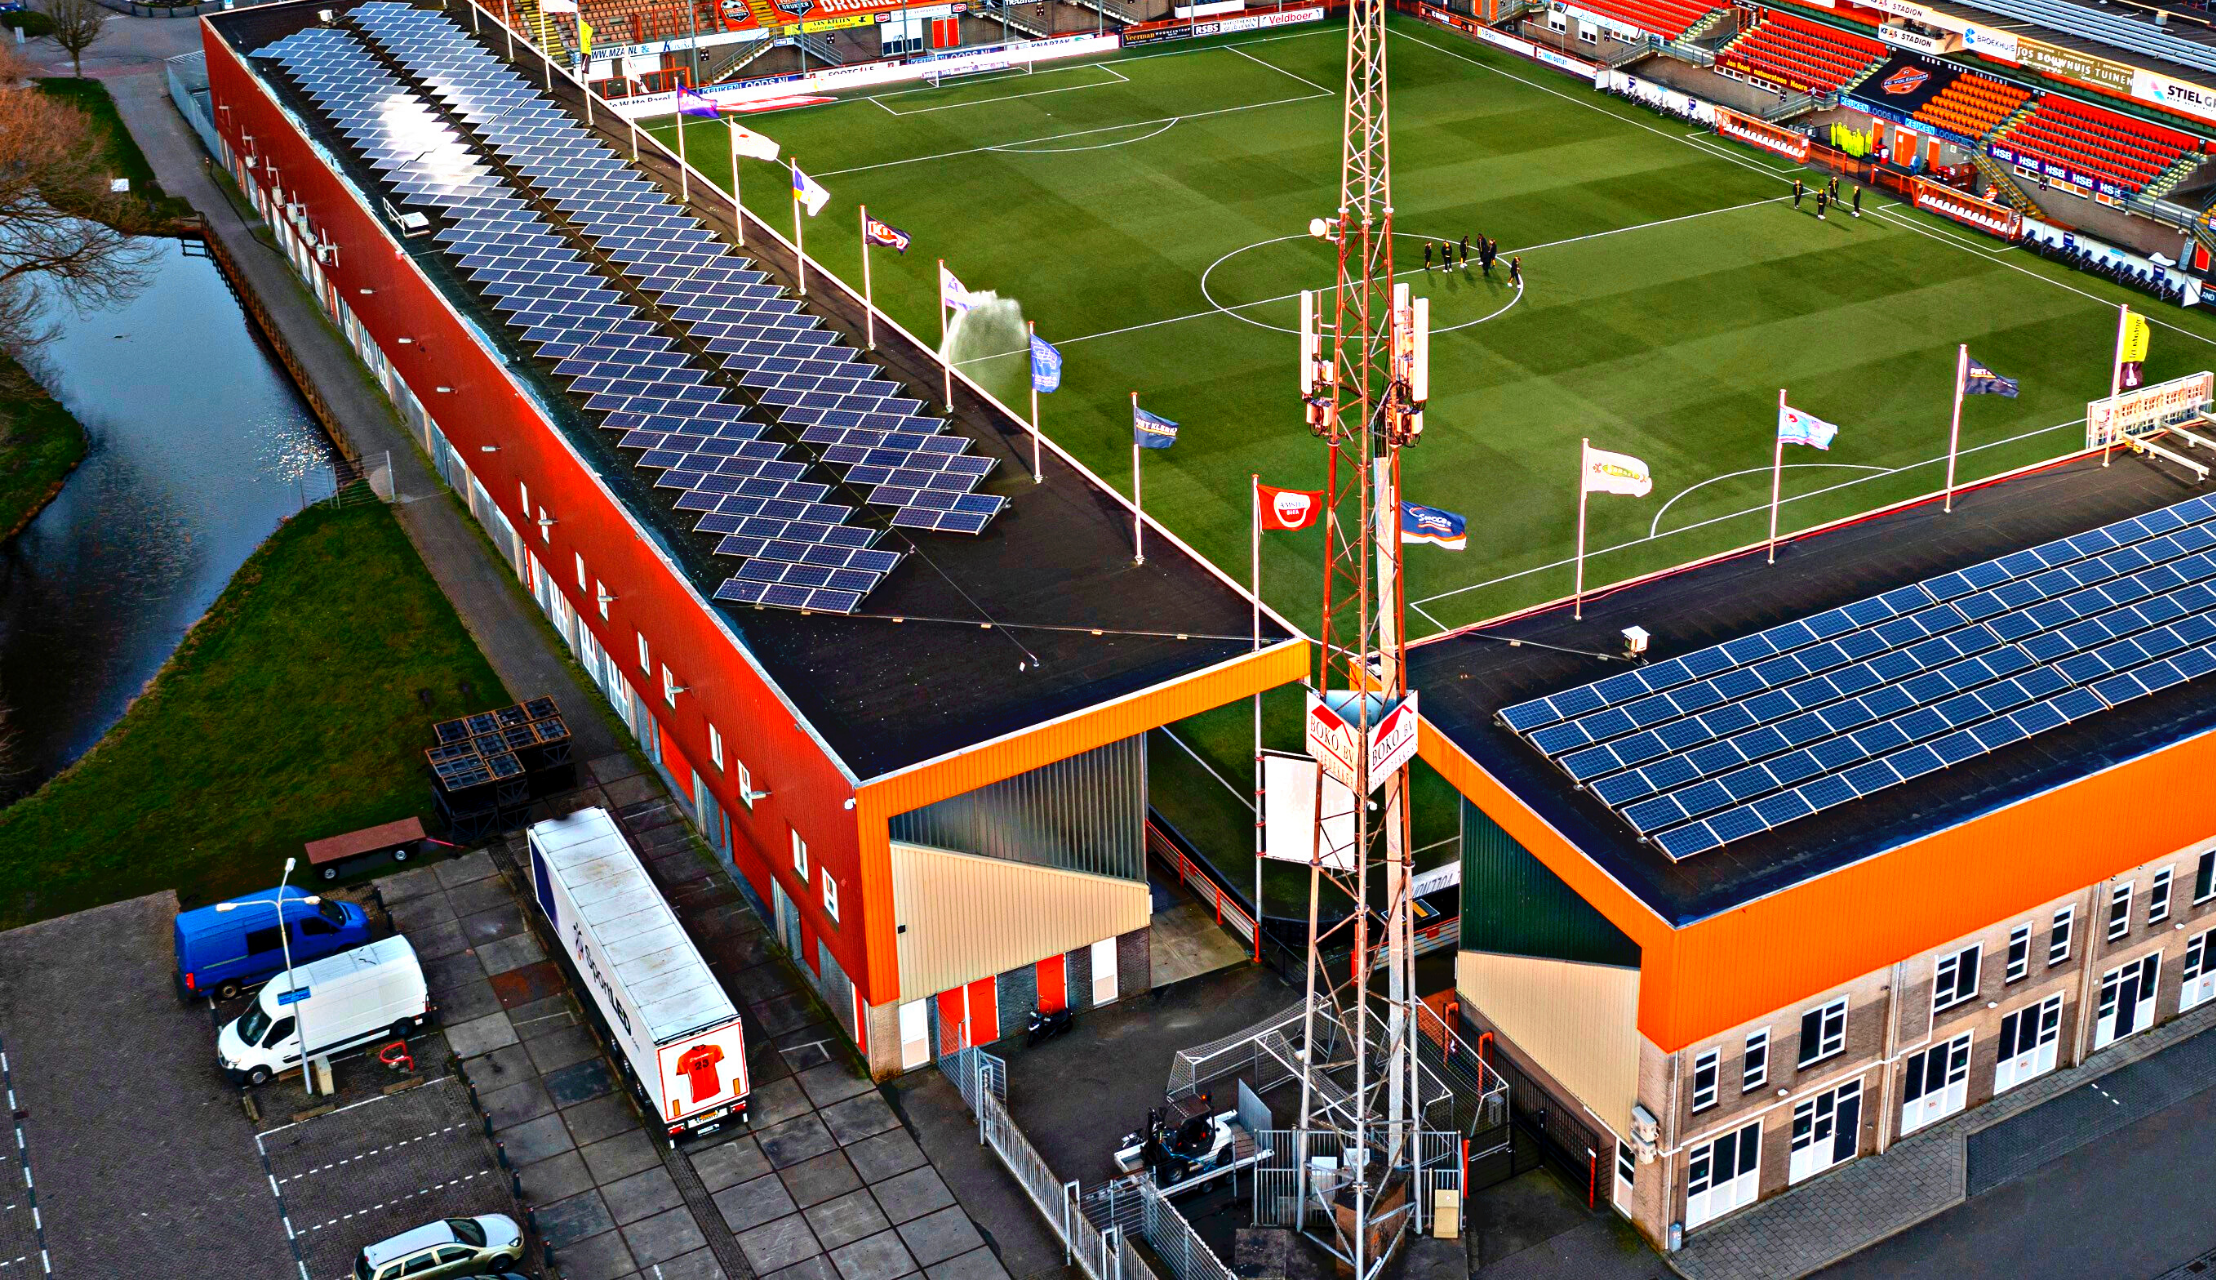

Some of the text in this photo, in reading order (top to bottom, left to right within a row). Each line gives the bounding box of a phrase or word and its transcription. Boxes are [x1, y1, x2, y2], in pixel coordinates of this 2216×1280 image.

[1892, 3, 1923, 17] STADION
[1269, 12, 1313, 24] Veldboer
[1196, 24, 1219, 34] RSBS
[1901, 33, 1933, 48] STADION
[1977, 35, 2016, 52] BROEKHUIS
[2016, 46, 2034, 59] JOS
[2095, 68, 2134, 87] TUINEN
[1726, 59, 1737, 68] Jan
[1754, 69, 1788, 85] natuursteen
[1790, 80, 1808, 91] Hoorn
[2168, 84, 2203, 104] STIEL
[1993, 147, 2013, 161] HSB
[2019, 155, 2039, 170] HSB
[2045, 164, 2066, 179] HSB
[2073, 173, 2094, 188] HSB
[1310, 715, 1354, 763] BOKO BV
[1372, 717, 1415, 767] BOKO BV
[694, 1058, 710, 1071] 23
